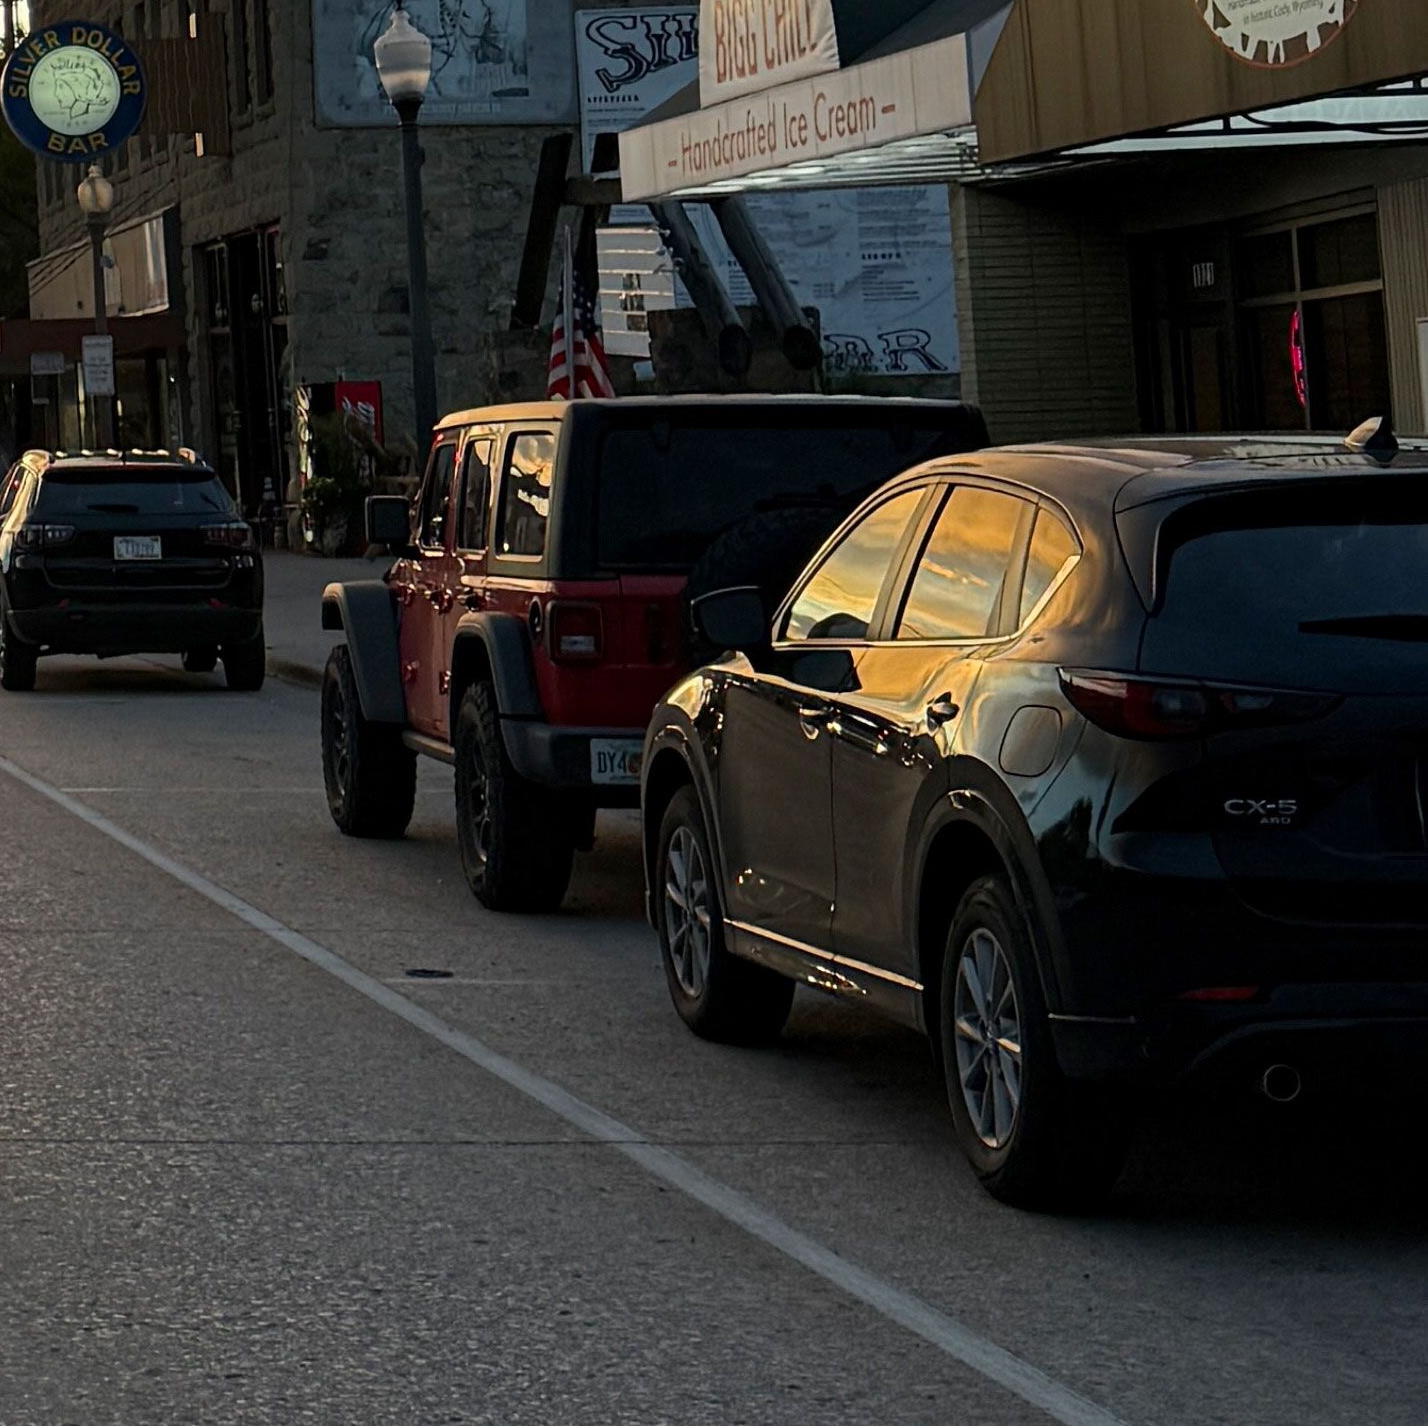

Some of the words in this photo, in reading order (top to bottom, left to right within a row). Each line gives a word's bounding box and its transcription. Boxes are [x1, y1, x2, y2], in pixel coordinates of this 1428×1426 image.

[9, 30, 62, 98] SILVER
[71, 26, 141, 95] DOLLAR
[47, 132, 109, 154] BAR
[681, 102, 776, 173] Handcrafted
[783, 102, 808, 149] Ice
[813, 92, 877, 142] Cream
[1224, 798, 1298, 816] CX-5
